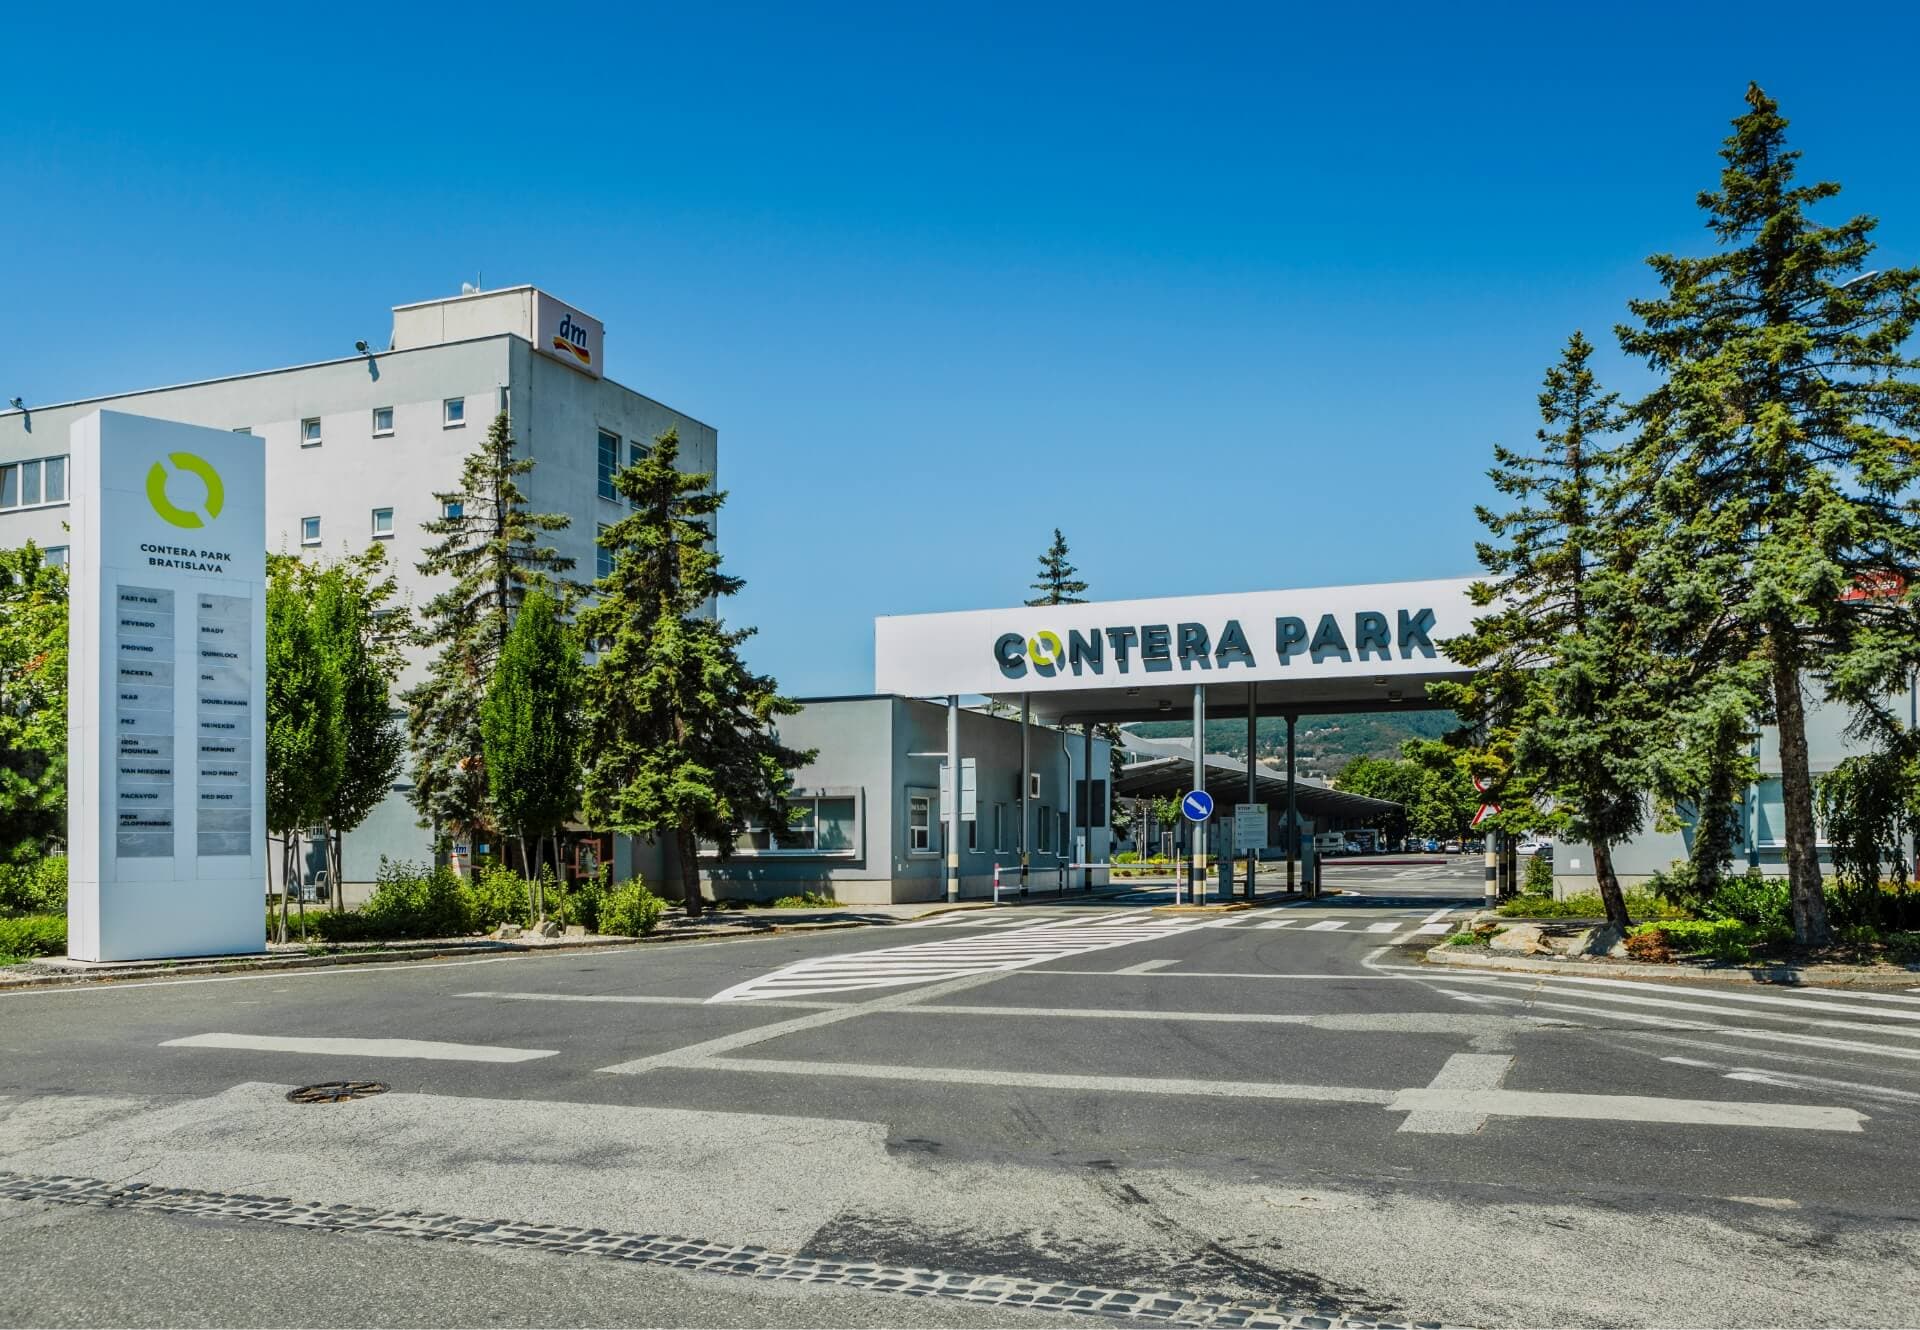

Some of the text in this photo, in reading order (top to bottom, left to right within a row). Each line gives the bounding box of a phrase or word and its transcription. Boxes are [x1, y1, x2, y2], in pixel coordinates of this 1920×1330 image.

[560, 313, 587, 348] dm
[140, 543, 232, 562] CONTERA PARK
[149, 557, 223, 573] BRATISLAVA
[994, 608, 1437, 670] CONTERA PARK
[120, 669, 153, 677] PACKETA
